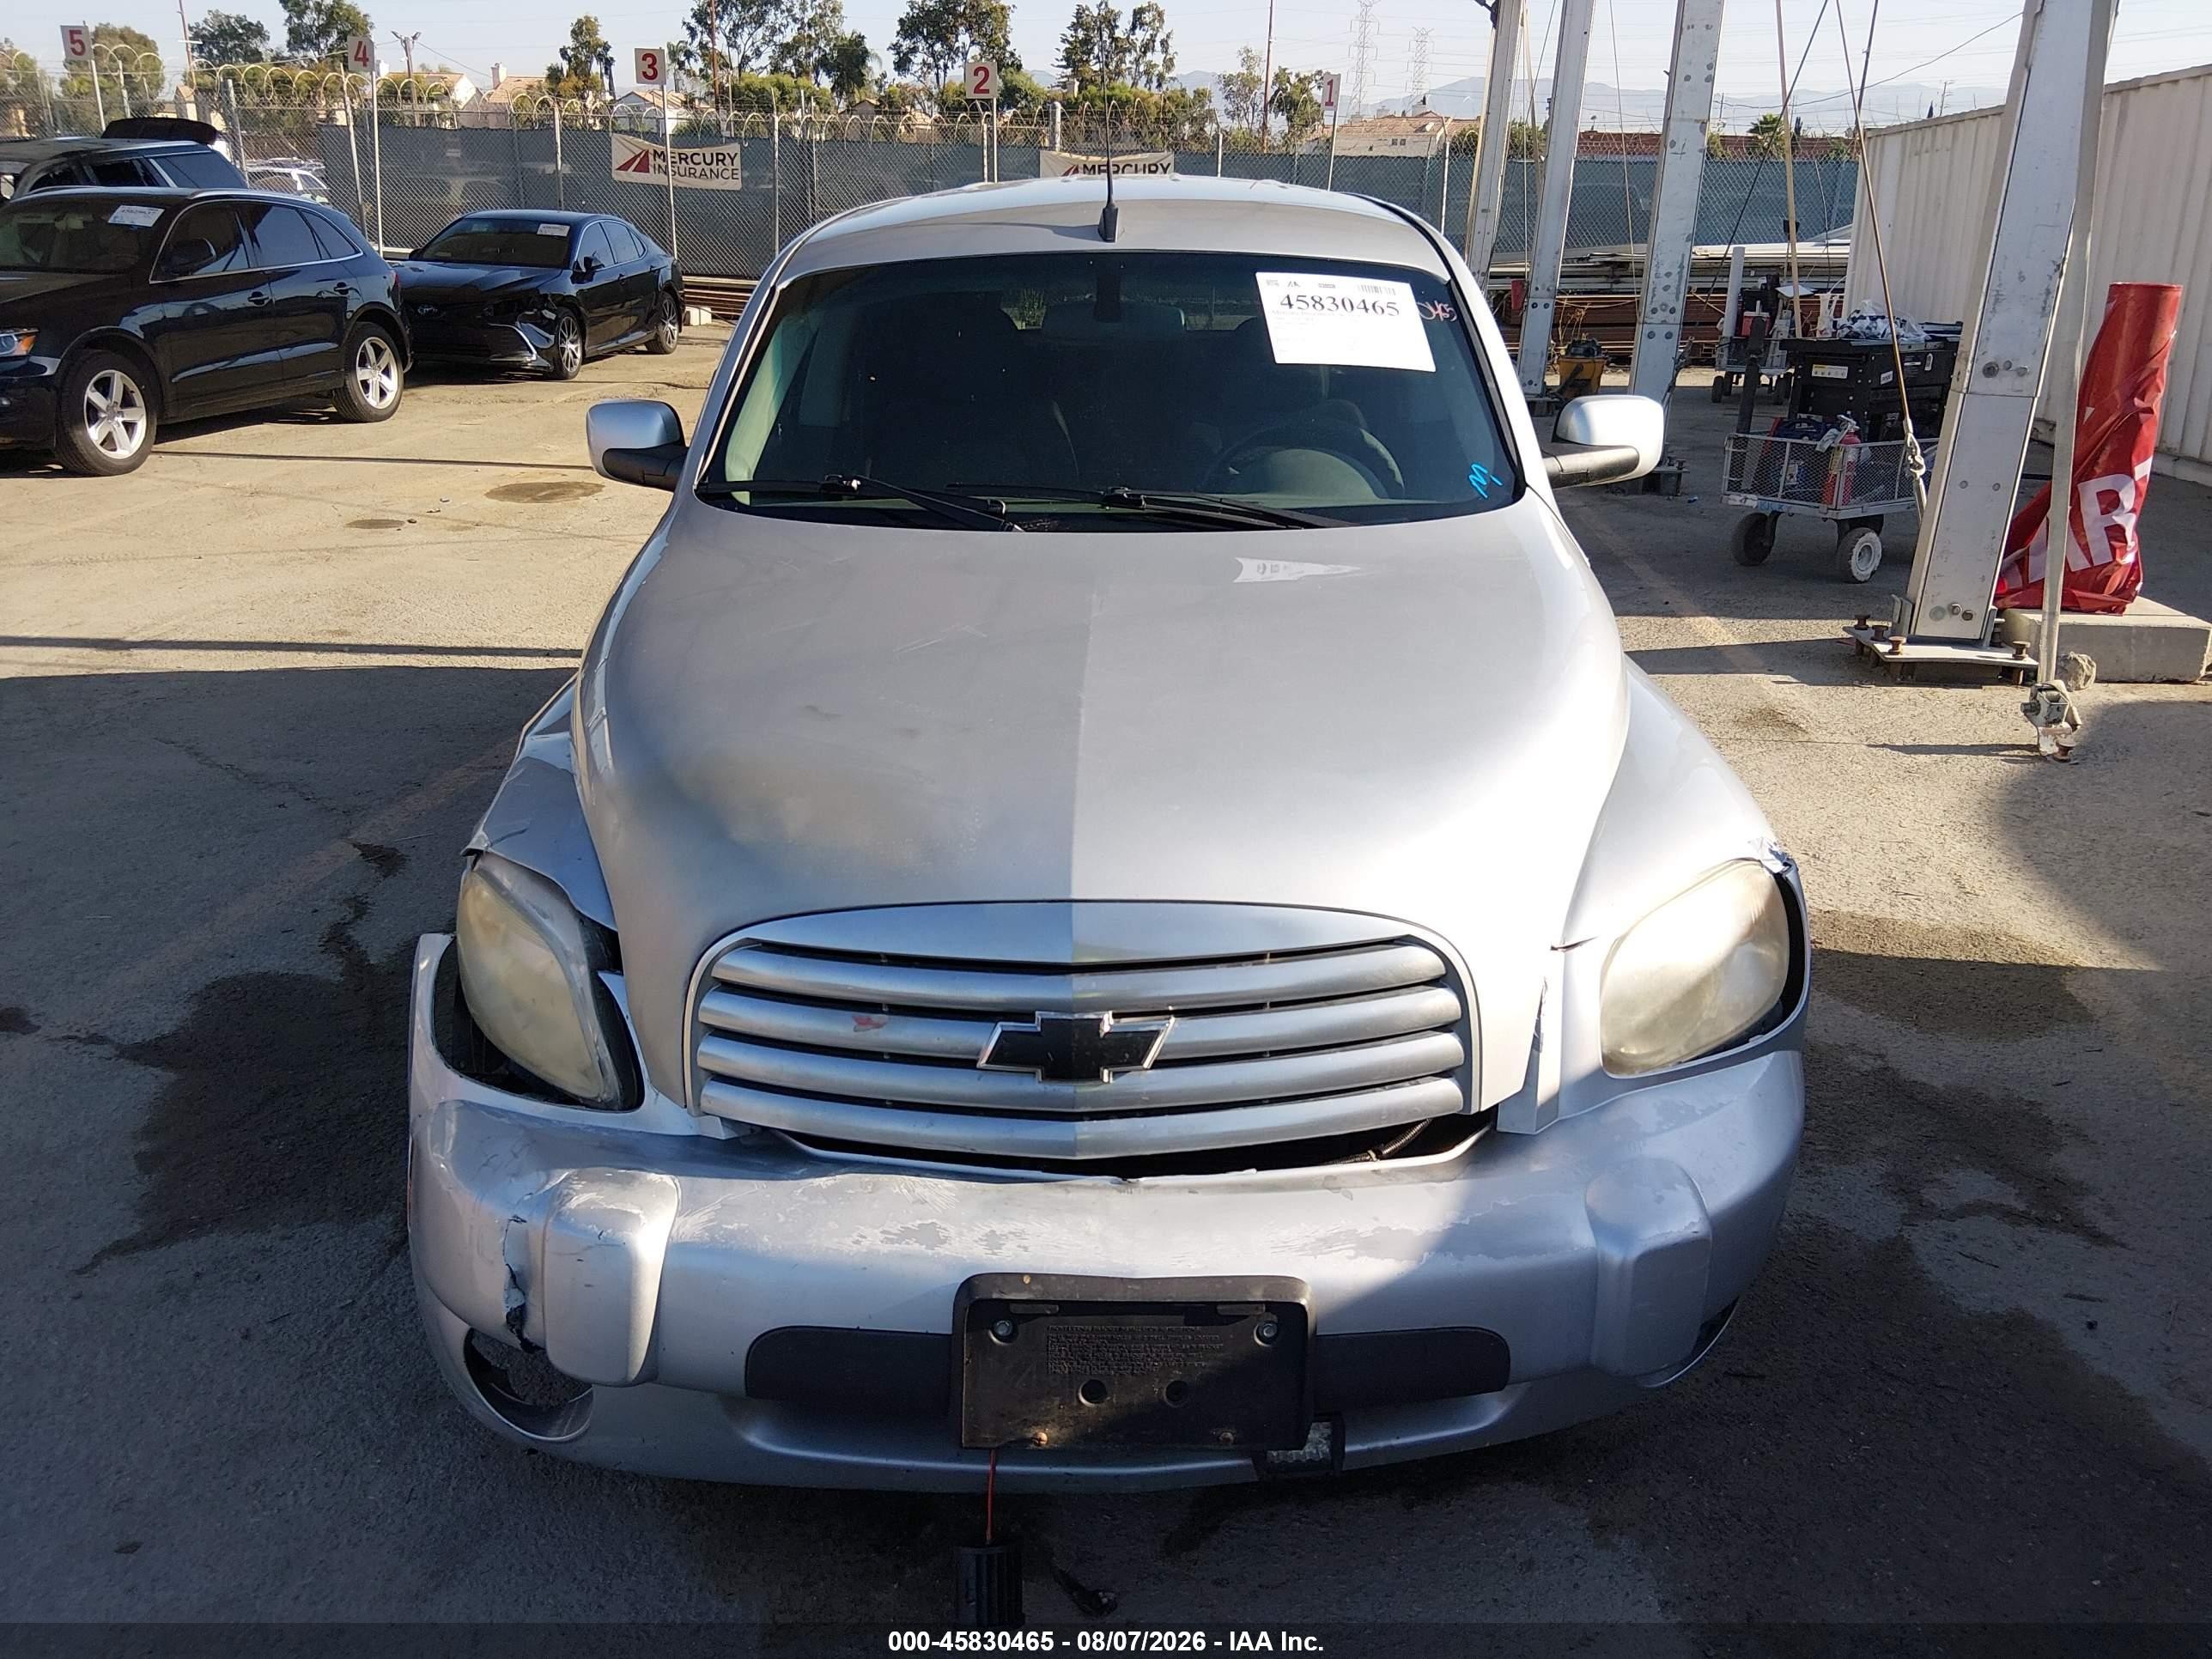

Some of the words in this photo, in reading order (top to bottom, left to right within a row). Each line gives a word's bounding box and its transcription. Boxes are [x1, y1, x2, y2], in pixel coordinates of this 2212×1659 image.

[69, 29, 86, 57] 5
[354, 40, 369, 68] 4
[641, 52, 659, 81] 3
[973, 66, 990, 94] 2
[1324, 78, 1334, 106] 1
[653, 149, 738, 167] MERCURY
[653, 163, 739, 180] INSURANCE
[1279, 294, 1400, 317] 45830465
